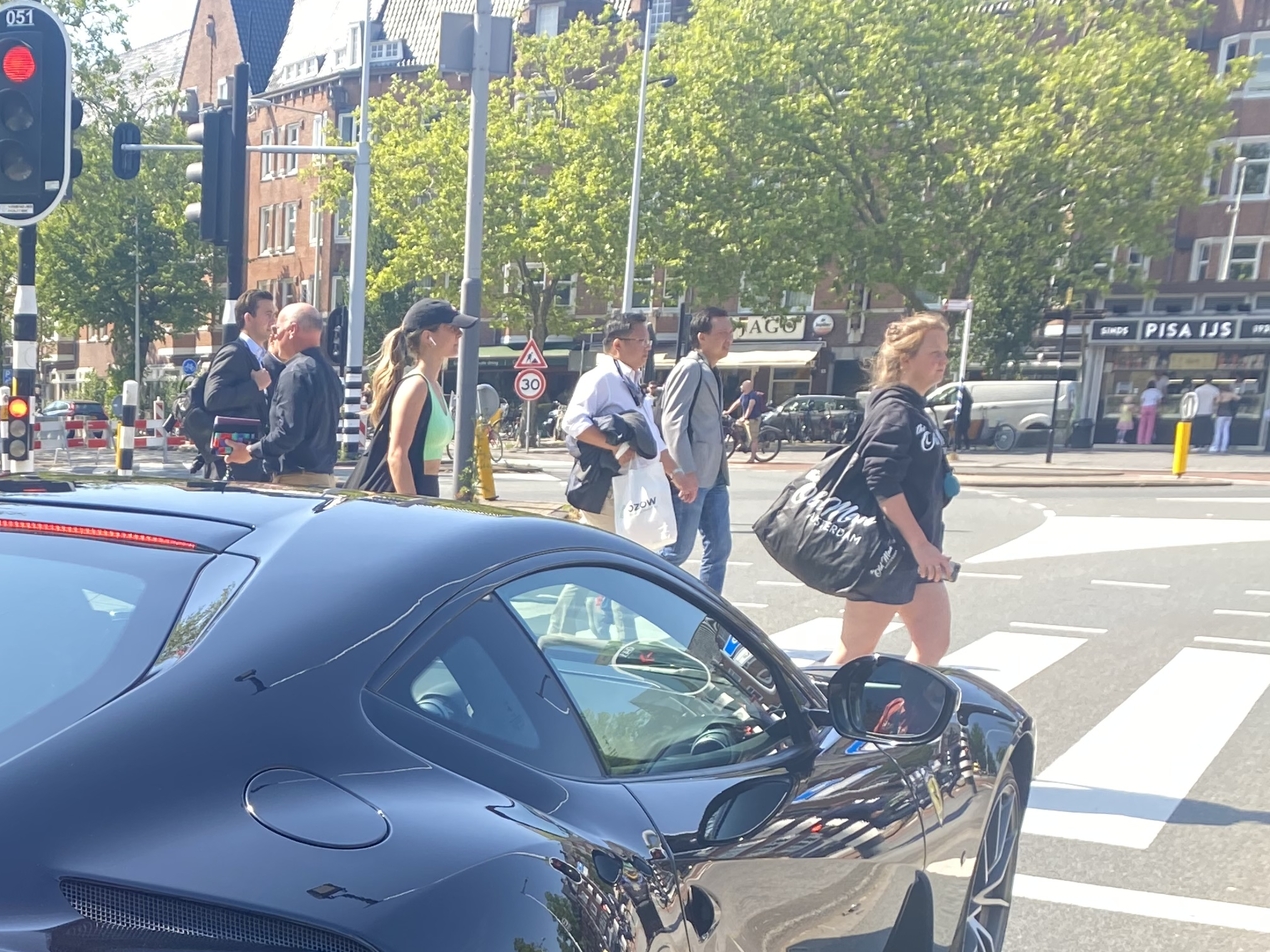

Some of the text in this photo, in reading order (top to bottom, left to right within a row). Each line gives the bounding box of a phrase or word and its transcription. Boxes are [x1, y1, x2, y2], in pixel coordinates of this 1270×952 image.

[6, 9, 34, 25] 051
[1101, 326, 1129, 336] SINDS
[1145, 321, 1232, 338] PISA IJS
[521, 379, 540, 391] 30
